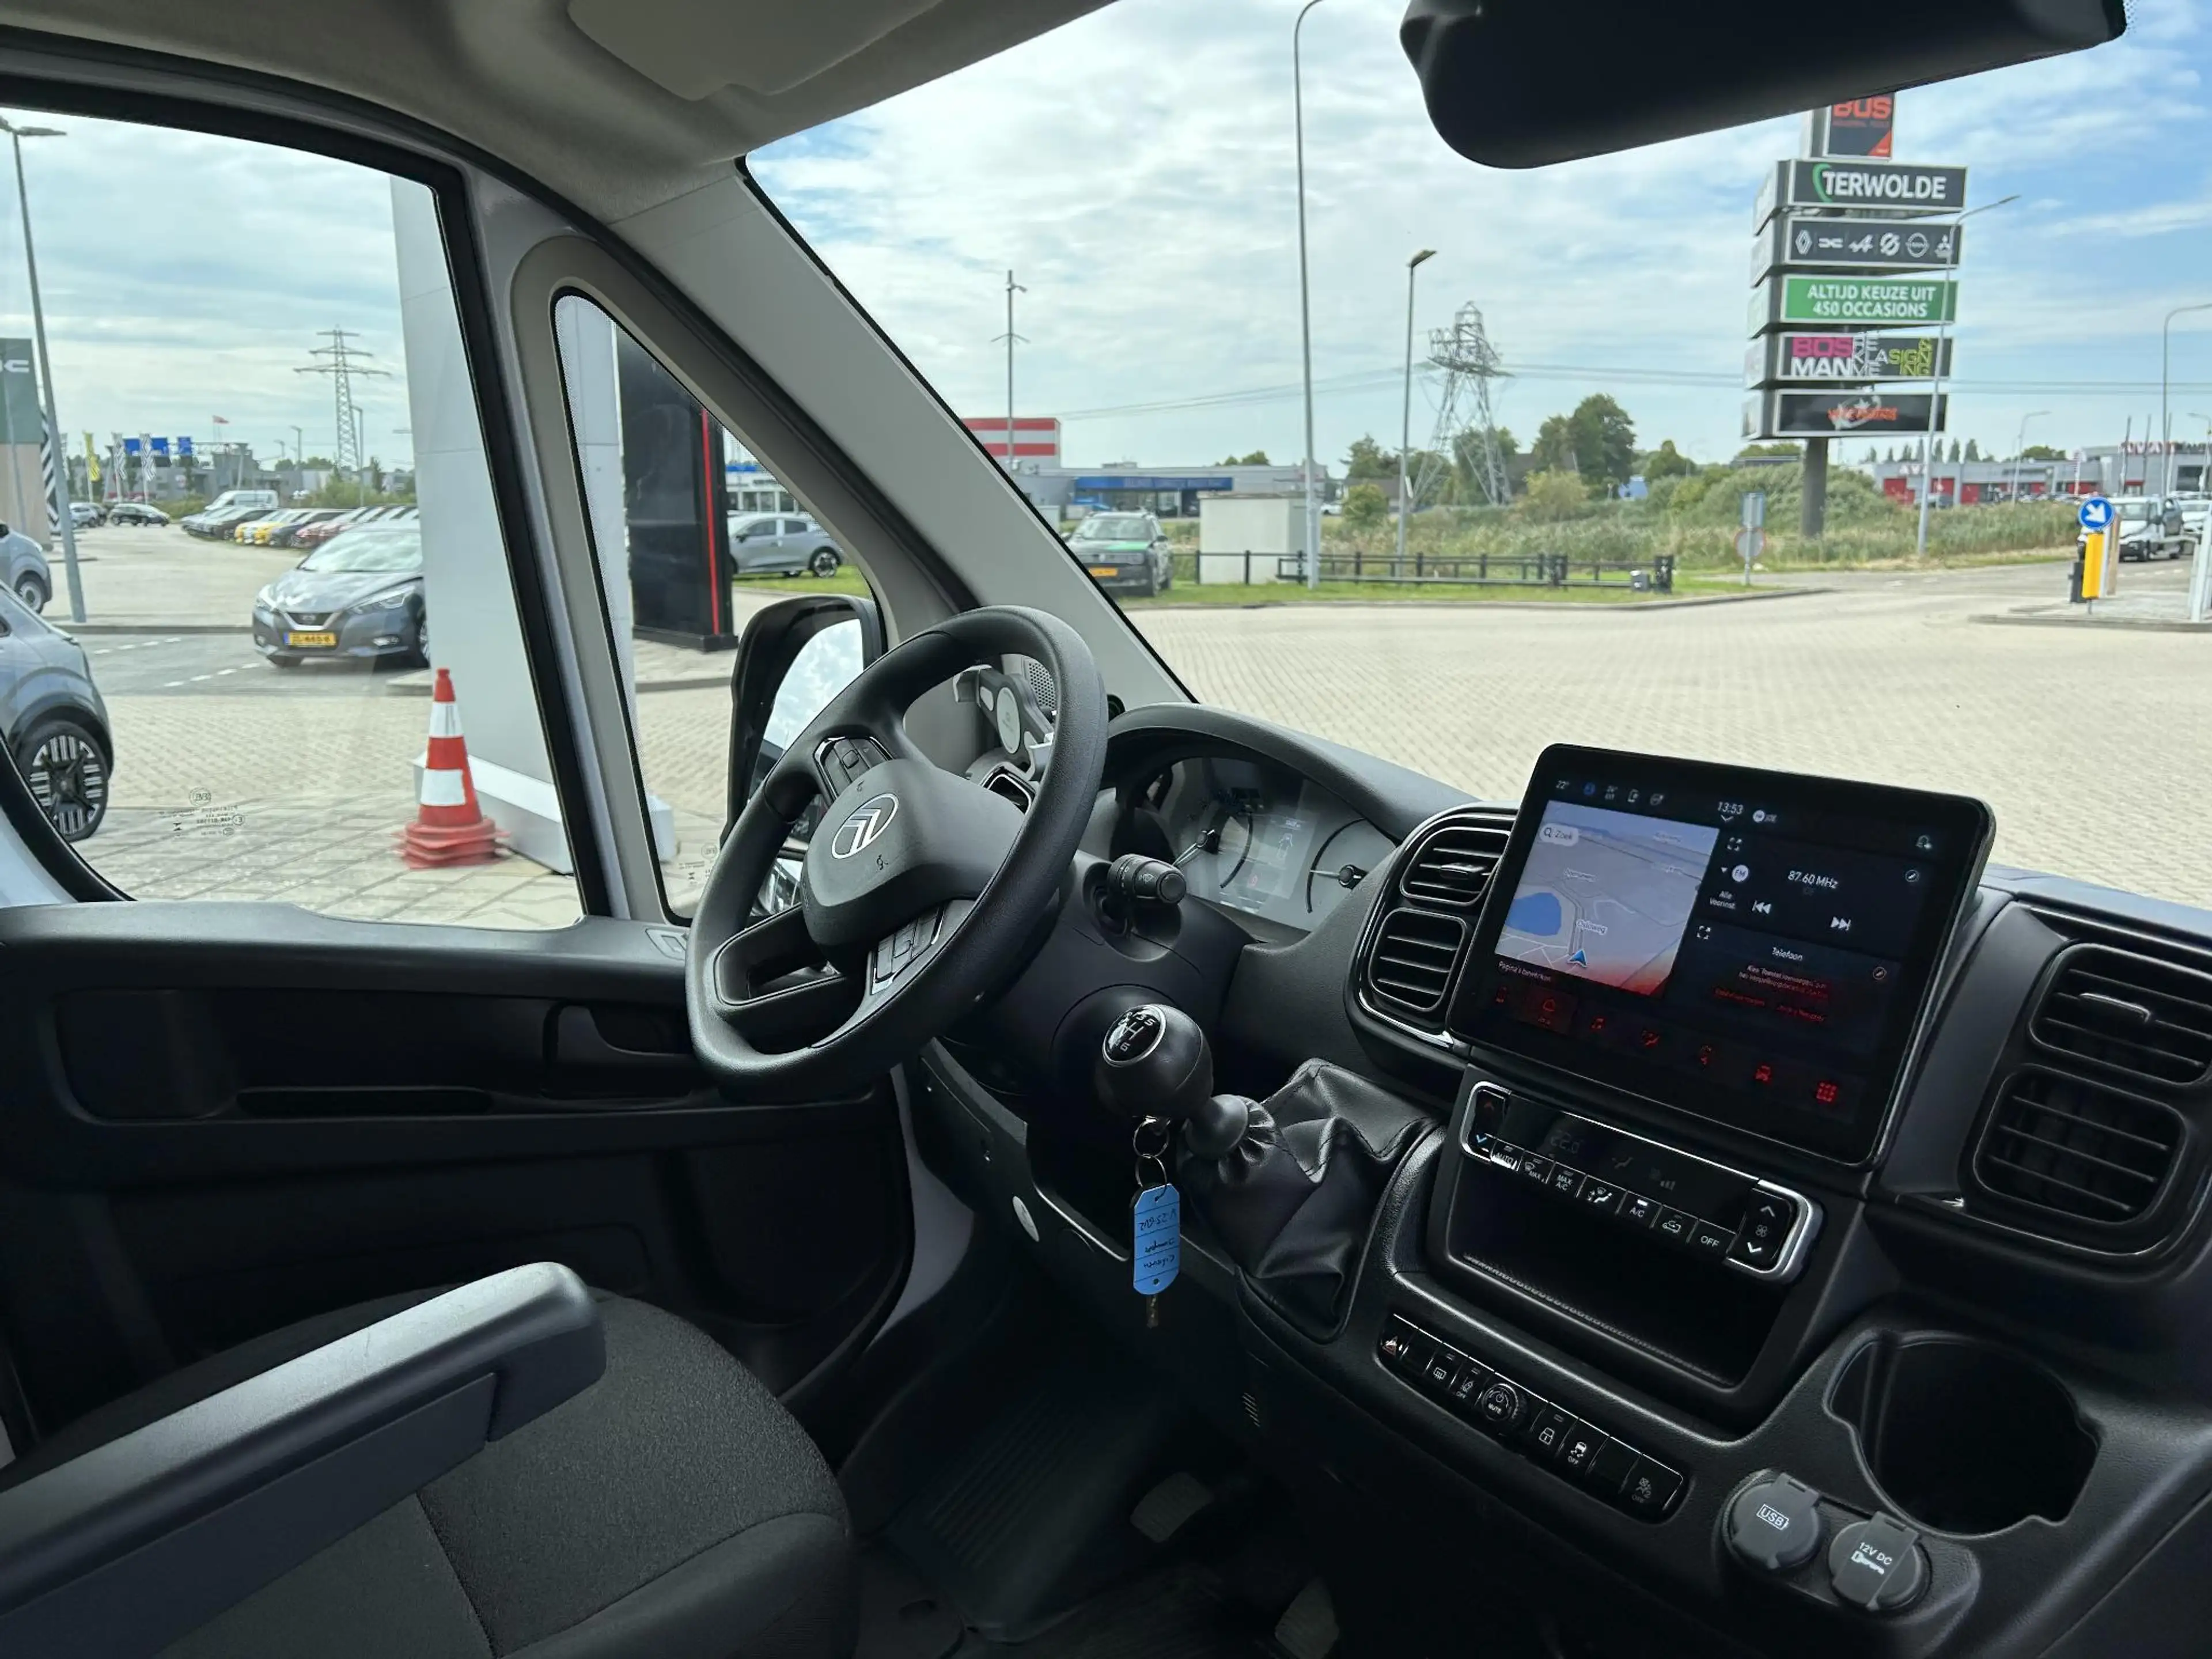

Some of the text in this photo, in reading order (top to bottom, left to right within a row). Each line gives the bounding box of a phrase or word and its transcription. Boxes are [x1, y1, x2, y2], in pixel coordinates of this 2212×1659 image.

[1822, 171, 1947, 200] TERWOLDE
[1808, 284, 1937, 302] ALTIJD KEUZE UIT
[1813, 301, 1929, 317] 450 OCCASIONS
[1793, 337, 1853, 357] BOS
[1790, 357, 1853, 377] MAN
[1717, 801, 1744, 815] 13:53
[1788, 870, 1839, 889] 87.60 MHz
[1120, 1041, 1131, 1052] 6
[1556, 1174, 1573, 1184] MAX
[1630, 1205, 1645, 1218] A/C
[1700, 1234, 1720, 1248] OFF
[1760, 1506, 1785, 1528] USB
[1859, 1541, 1893, 1566] 12V DC
